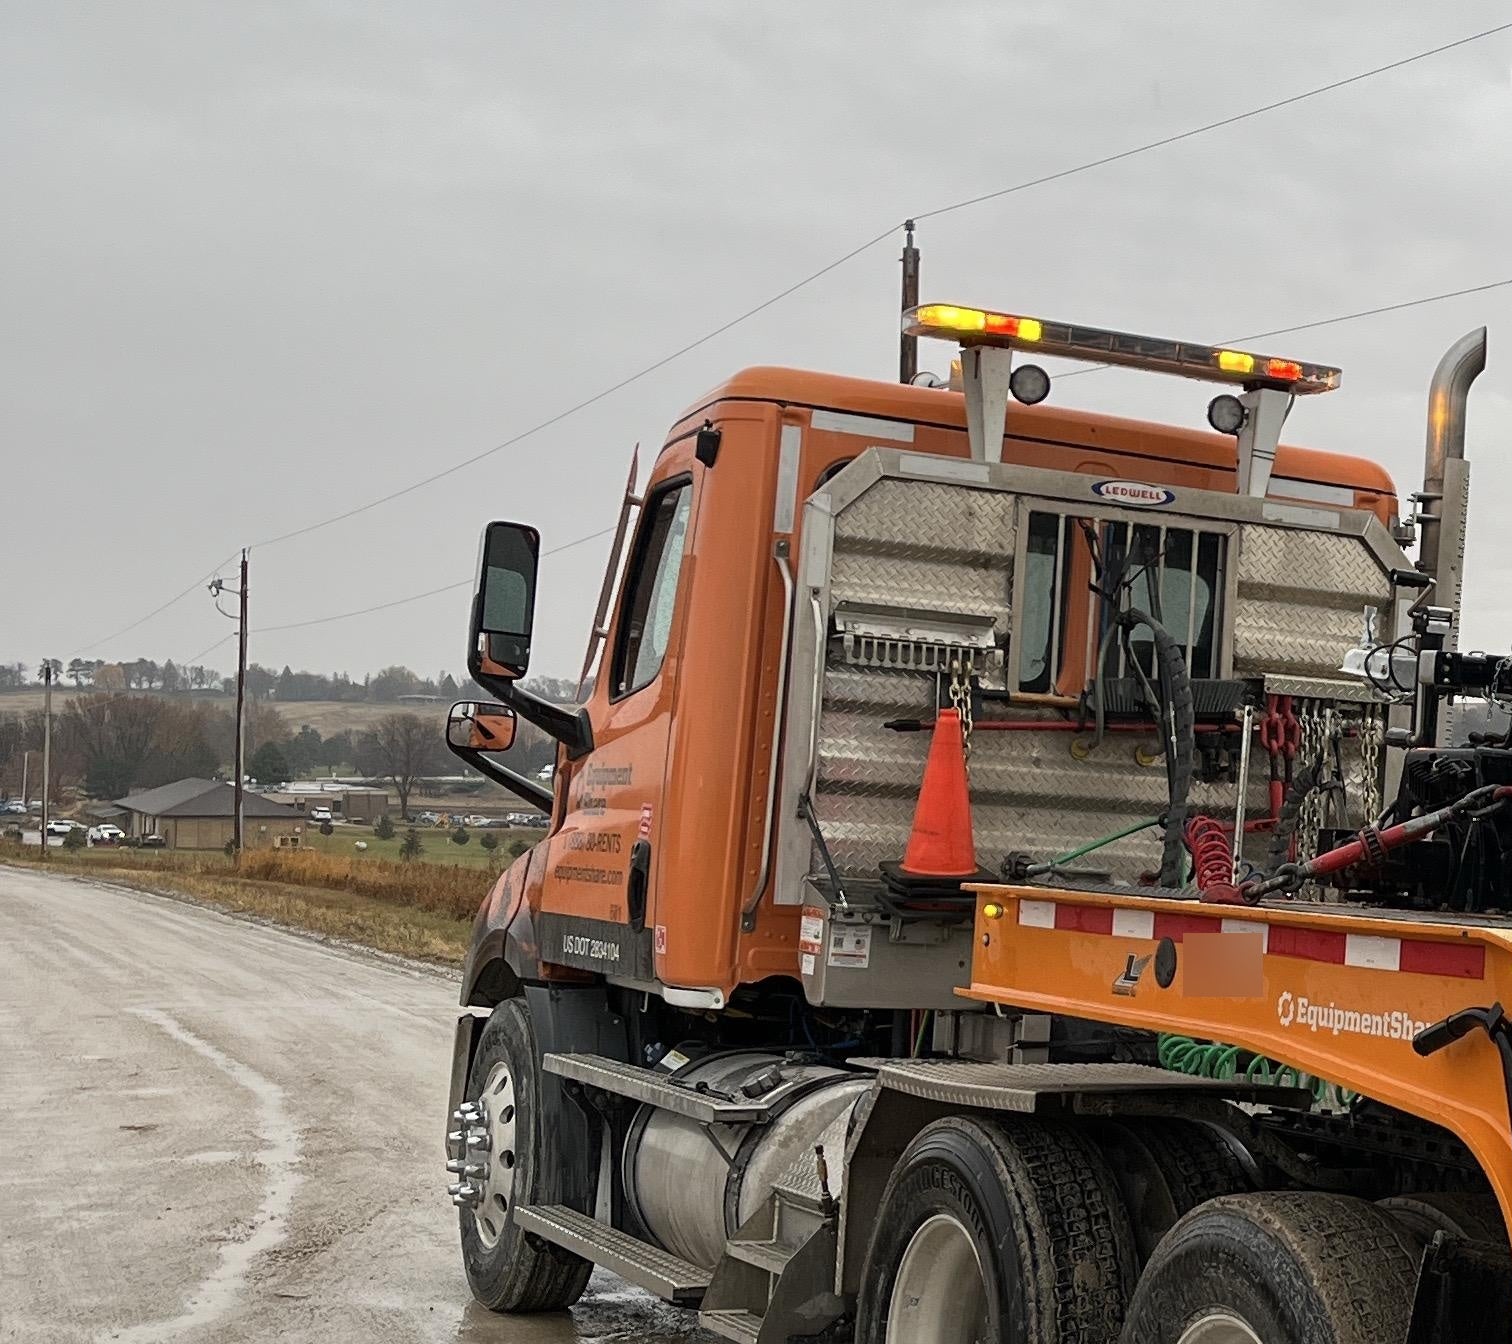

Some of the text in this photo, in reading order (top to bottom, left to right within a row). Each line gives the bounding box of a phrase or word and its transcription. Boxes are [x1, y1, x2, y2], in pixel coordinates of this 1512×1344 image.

[1105, 485, 1162, 500] LEDWELL
[563, 935, 620, 961] US DOT 2834104
